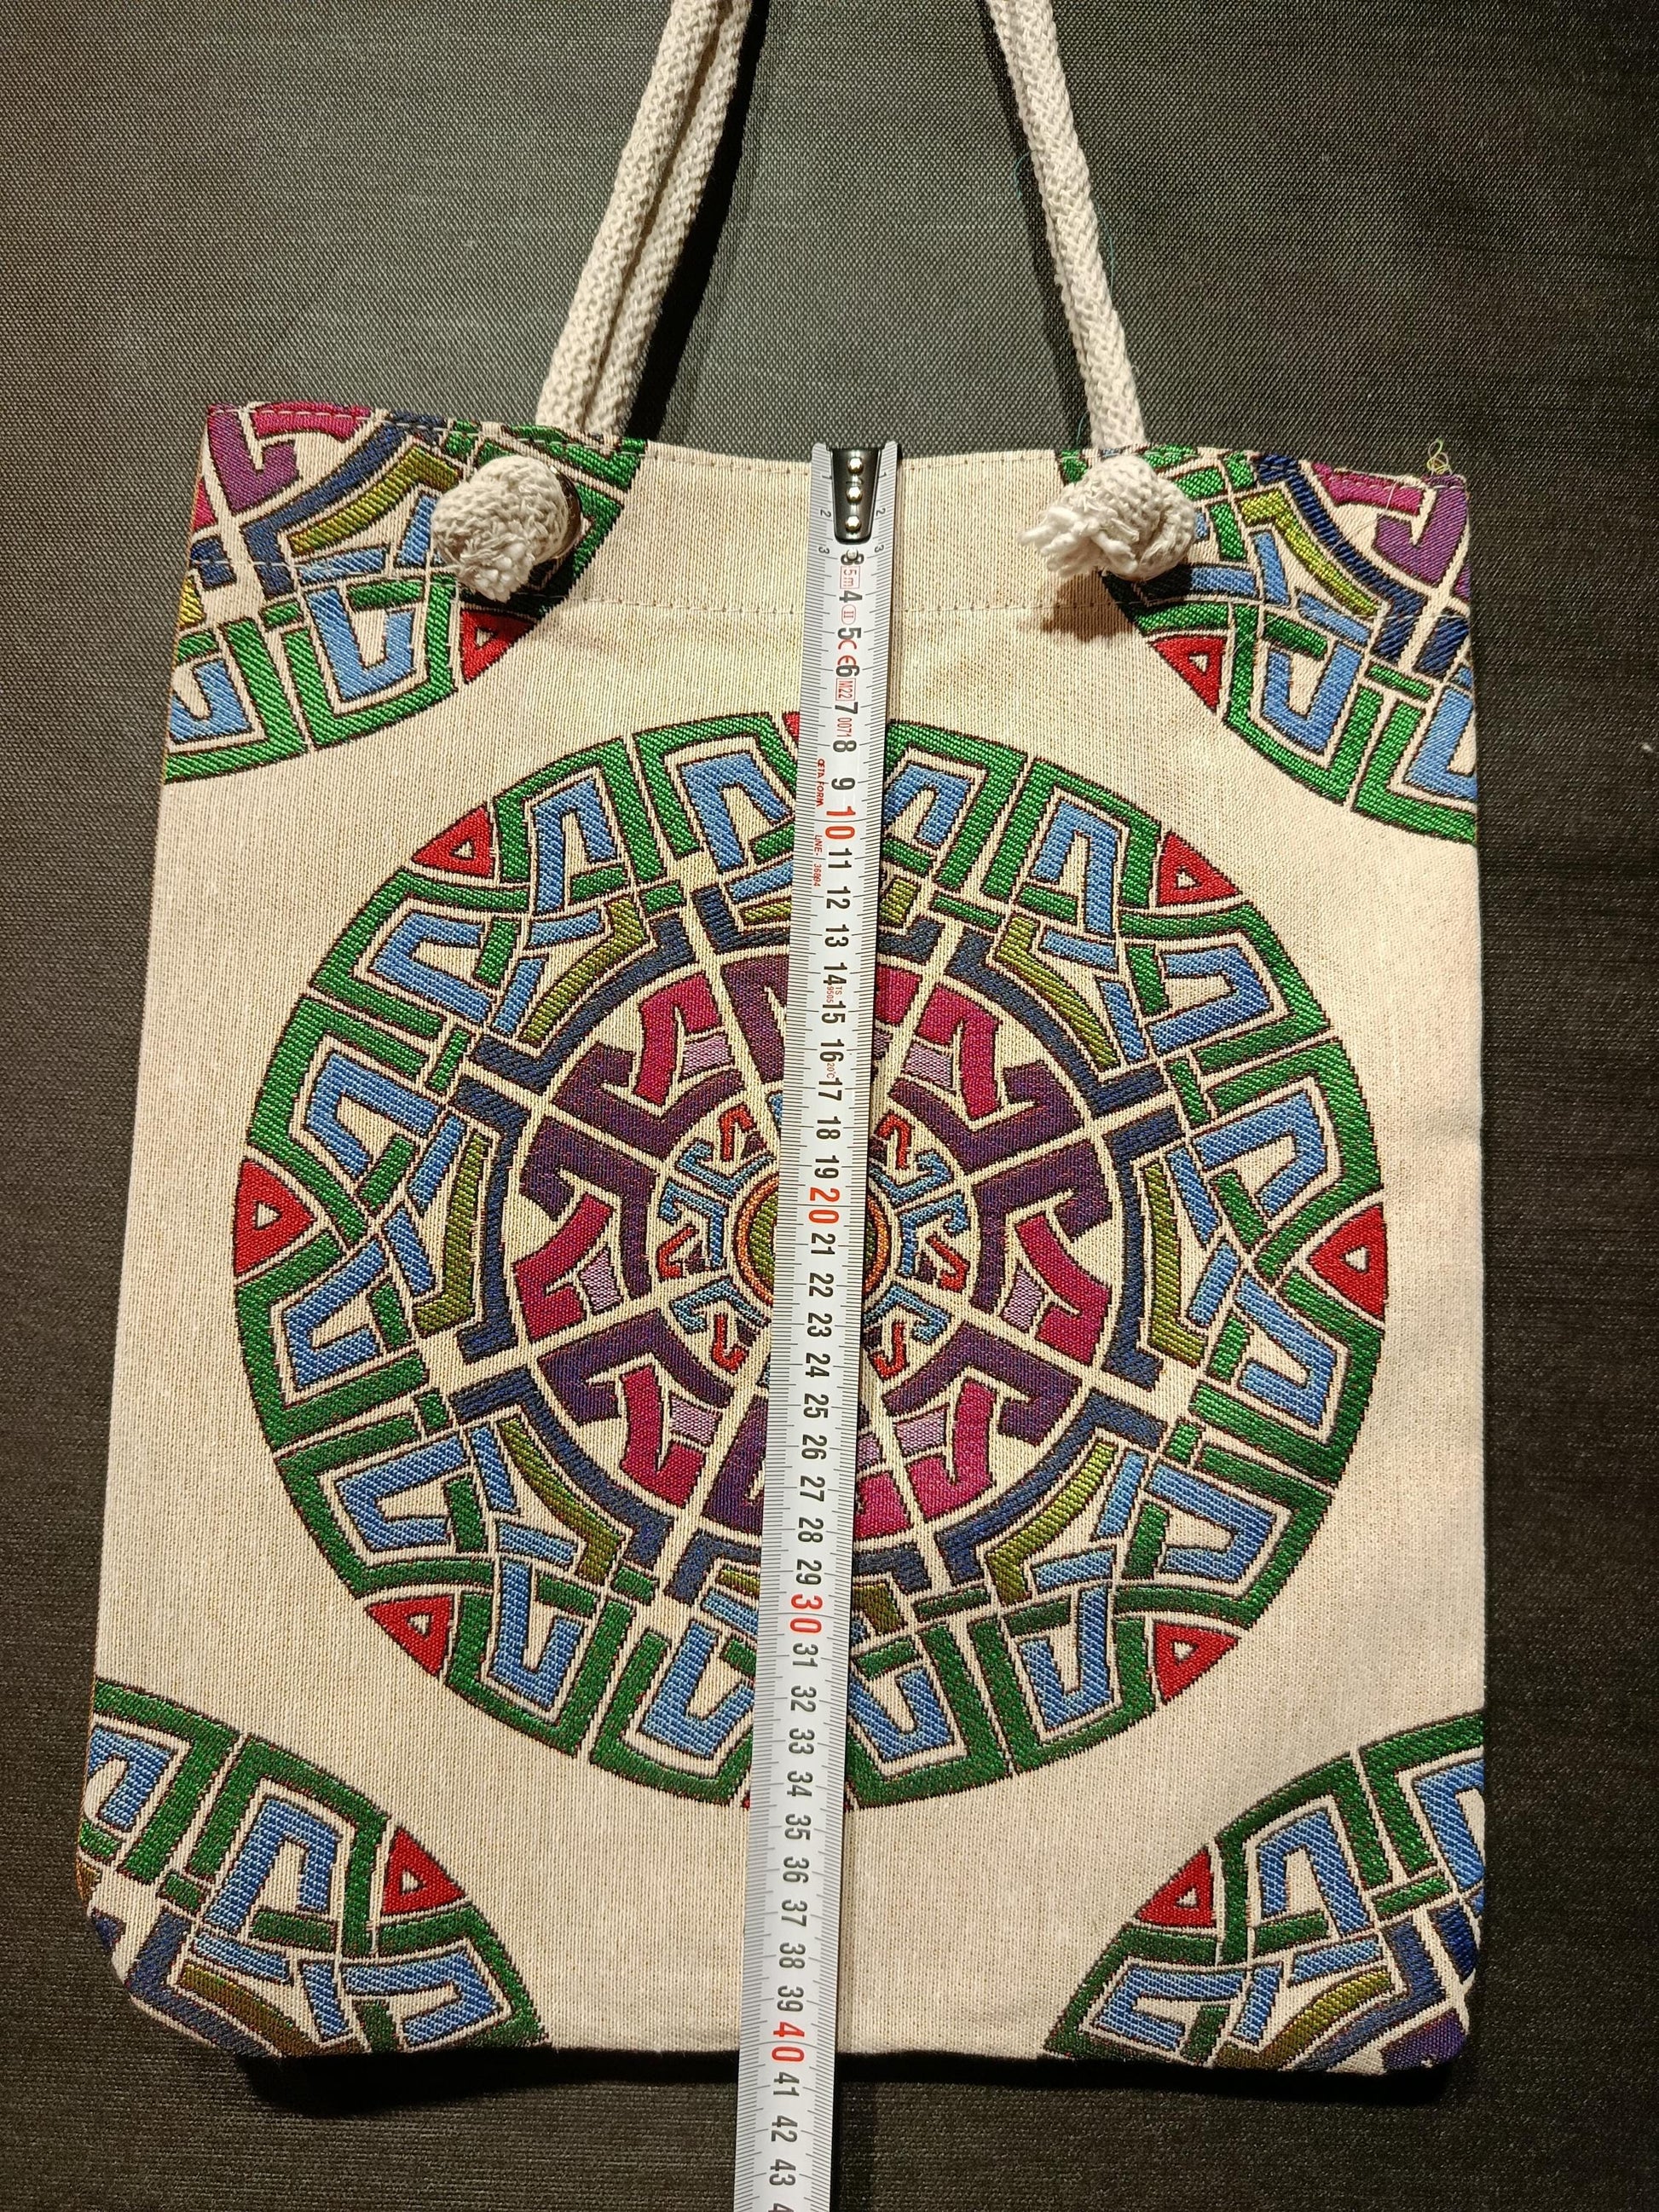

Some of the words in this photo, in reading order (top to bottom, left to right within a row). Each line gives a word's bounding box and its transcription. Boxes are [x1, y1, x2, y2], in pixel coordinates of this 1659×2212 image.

[820, 508, 831, 517] 2
[876, 507, 886, 517] 2
[818, 546, 830, 554] 3
[874, 544, 884, 553] 3
[843, 569, 857, 587] 5m
[839, 590, 863, 604] 4
[837, 627, 861, 639] 5
[835, 664, 860, 678] 6
[837, 679, 853, 699] M22
[835, 702, 858, 714] 7
[836, 717, 853, 737] 0071
[833, 740, 857, 753] 8
[816, 782, 824, 806] FORM
[831, 777, 856, 790] 9
[825, 806, 856, 840] 10
[828, 848, 853, 868] 11
[826, 886, 851, 910] 12
[824, 923, 849, 947] 13
[823, 962, 848, 986] 14
[835, 985, 843, 996] TS
[821, 1001, 846, 1024] 15
[819, 1038, 845, 1062] 16
[818, 1077, 843, 1101] 17
[816, 1116, 841, 1140] 18
[814, 1155, 840, 1179] 19
[808, 1187, 841, 1224] 20
[811, 1233, 835, 1256] 21
[808, 1272, 834, 1298] 22
[806, 1312, 832, 1337] 23
[805, 1352, 830, 1377] 24
[803, 1393, 830, 1418] 25
[801, 1434, 827, 1460] 26
[800, 1476, 825, 1502] 27
[798, 1516, 824, 1543] 28
[795, 1558, 822, 1585] 29
[789, 1593, 824, 1634] 30
[792, 1643, 818, 1668] 31
[790, 1685, 817, 1712] 32
[788, 1728, 815, 1755] 33
[786, 1770, 813, 1798] 34
[784, 1813, 812, 1840] 35
[783, 1857, 810, 1884] 36
[781, 1899, 807, 1927] 37
[779, 1942, 806, 1969] 38
[777, 1985, 804, 2013] 39
[772, 2022, 805, 2063] 40
[773, 2071, 800, 2096] 41
[771, 2116, 798, 2143] 42
[769, 2158, 796, 2186] 43
